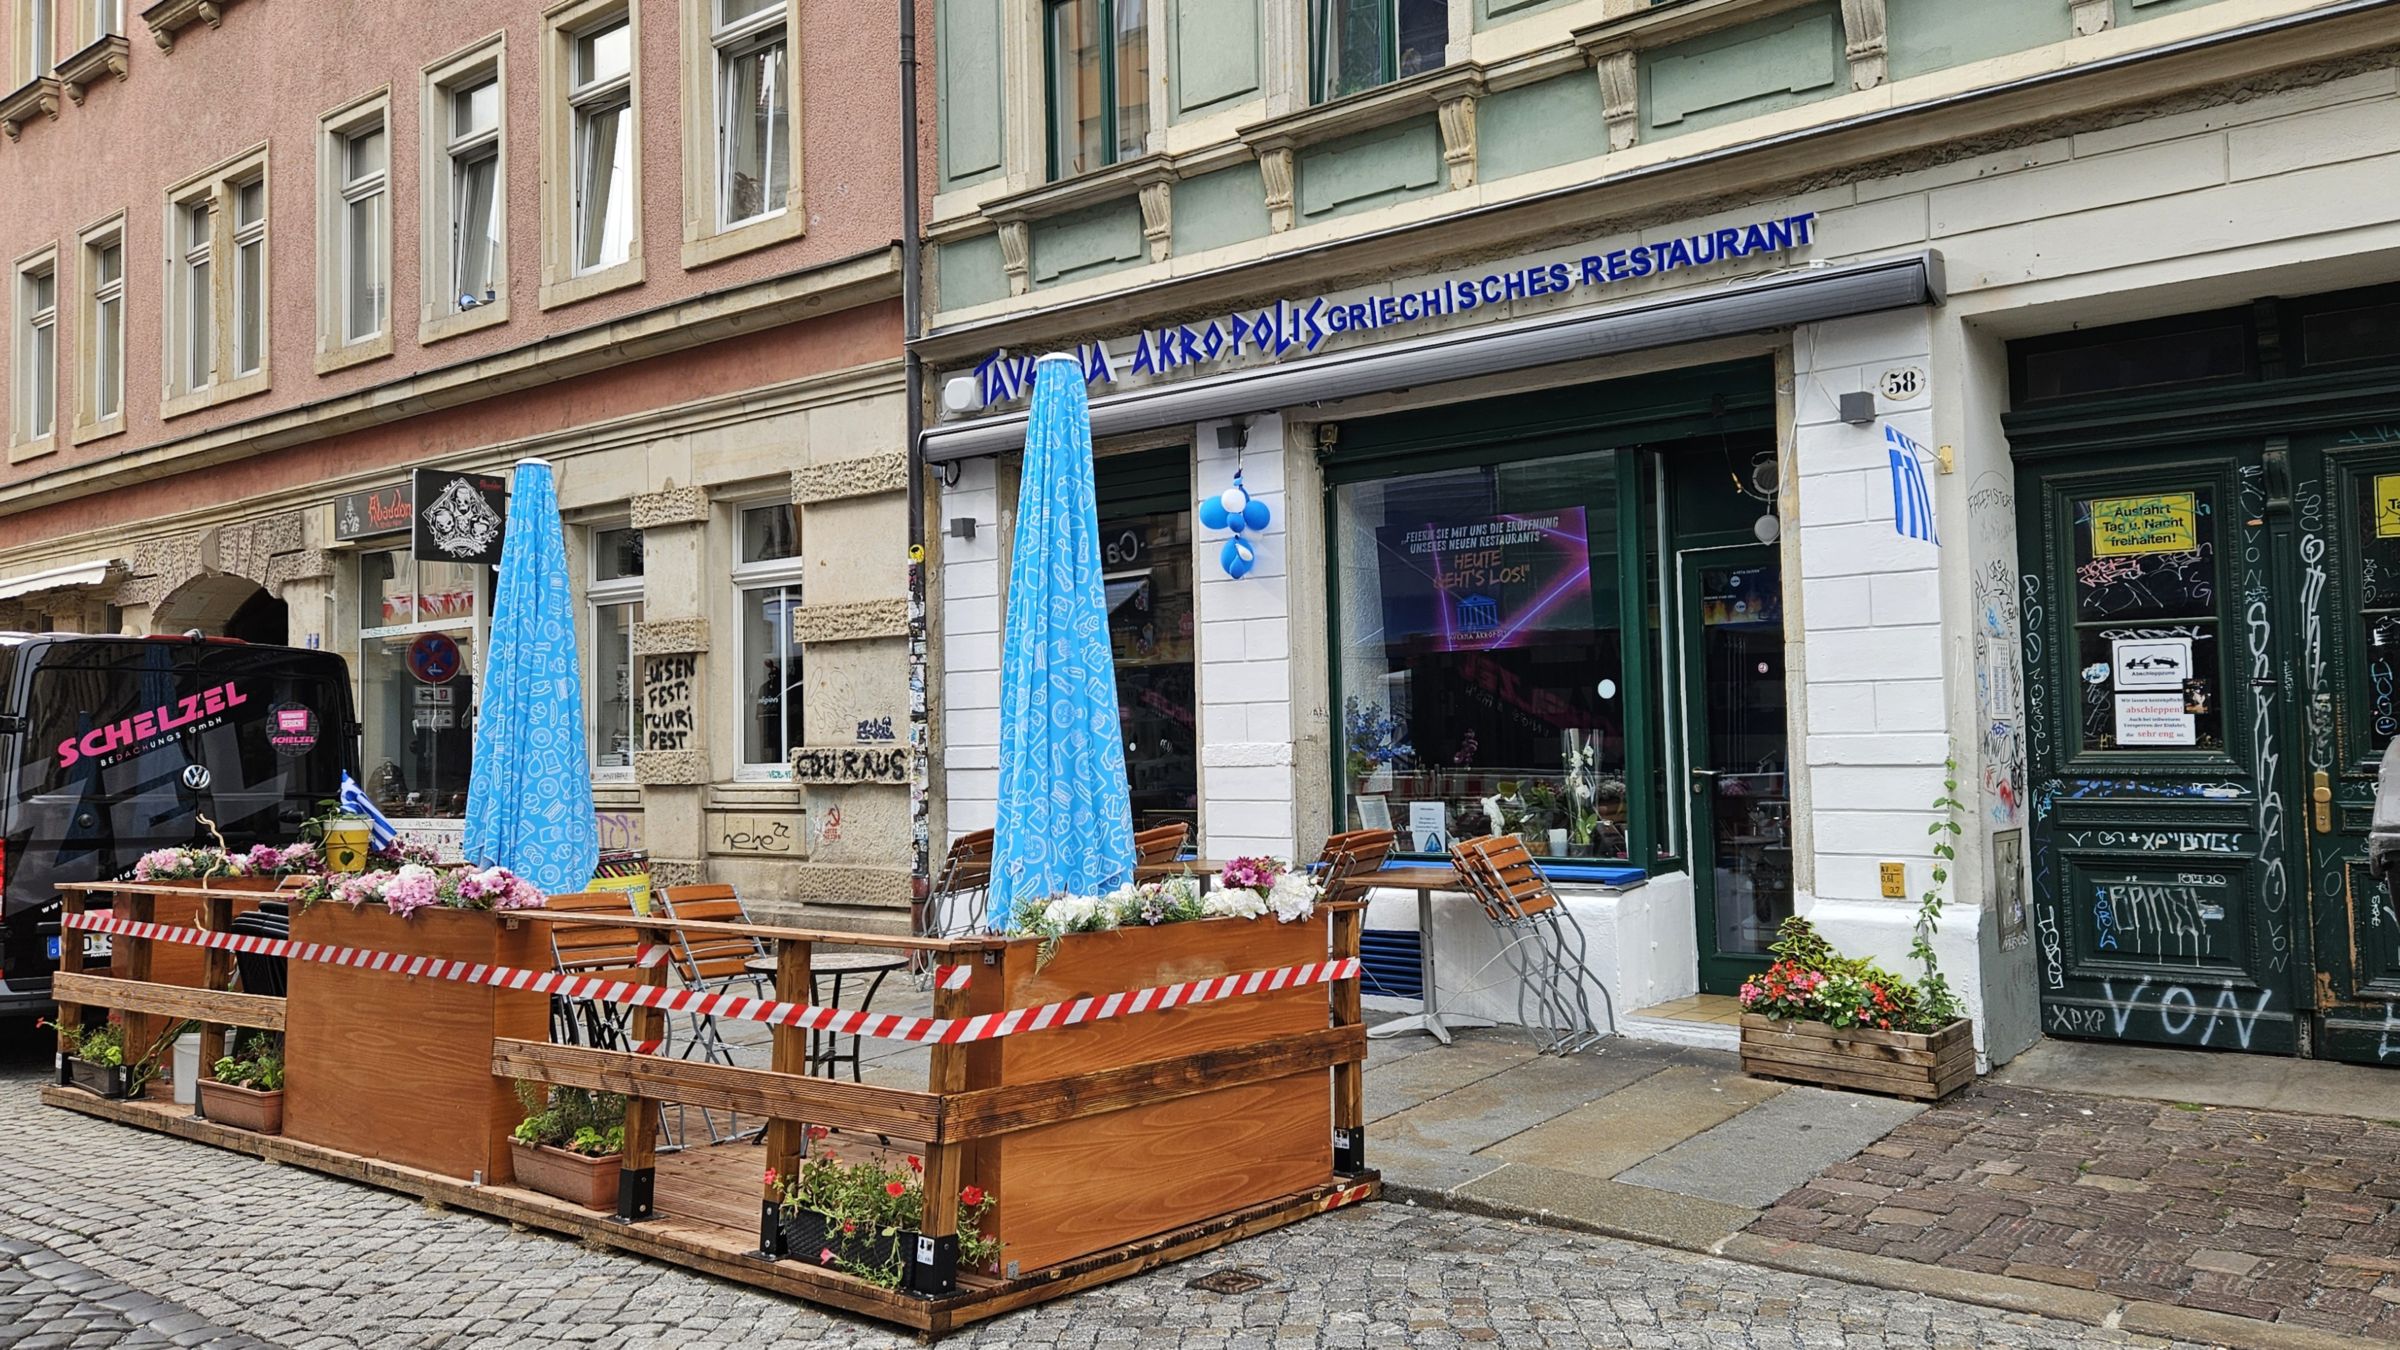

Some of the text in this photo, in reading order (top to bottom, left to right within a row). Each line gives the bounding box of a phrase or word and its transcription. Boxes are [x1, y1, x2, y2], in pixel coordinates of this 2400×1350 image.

[1132, 296, 1325, 377] AKROPOLIS
[1327, 265, 1571, 333] GRIECHISCHES
[1582, 212, 1817, 287] RESTAURANT
[1889, 371, 1916, 394] 58
[2115, 504, 2171, 517] Ausfahrt
[1451, 526, 1468, 539] MIT
[1469, 524, 1487, 537] UNS
[1490, 522, 1504, 534] DIE
[2103, 521, 2126, 533] Tag
[2144, 517, 2184, 529] Nacht
[1449, 537, 1477, 550] NEUEN
[1480, 531, 1540, 547] RESTAURANTS
[2111, 533, 2177, 547] freihalten!
[1454, 550, 1502, 569] HEUTE
[648, 681, 689, 708] FEST:
[2127, 706, 2183, 715] abschleppen!
[57, 681, 248, 769] SCHELZEL
[650, 731, 688, 750] PEST
[2159, 731, 2175, 739] eng
[100, 731, 182, 767] BEDACHUNGS
[841, 749, 906, 780] RAUS
[2103, 975, 2272, 1048] VON
